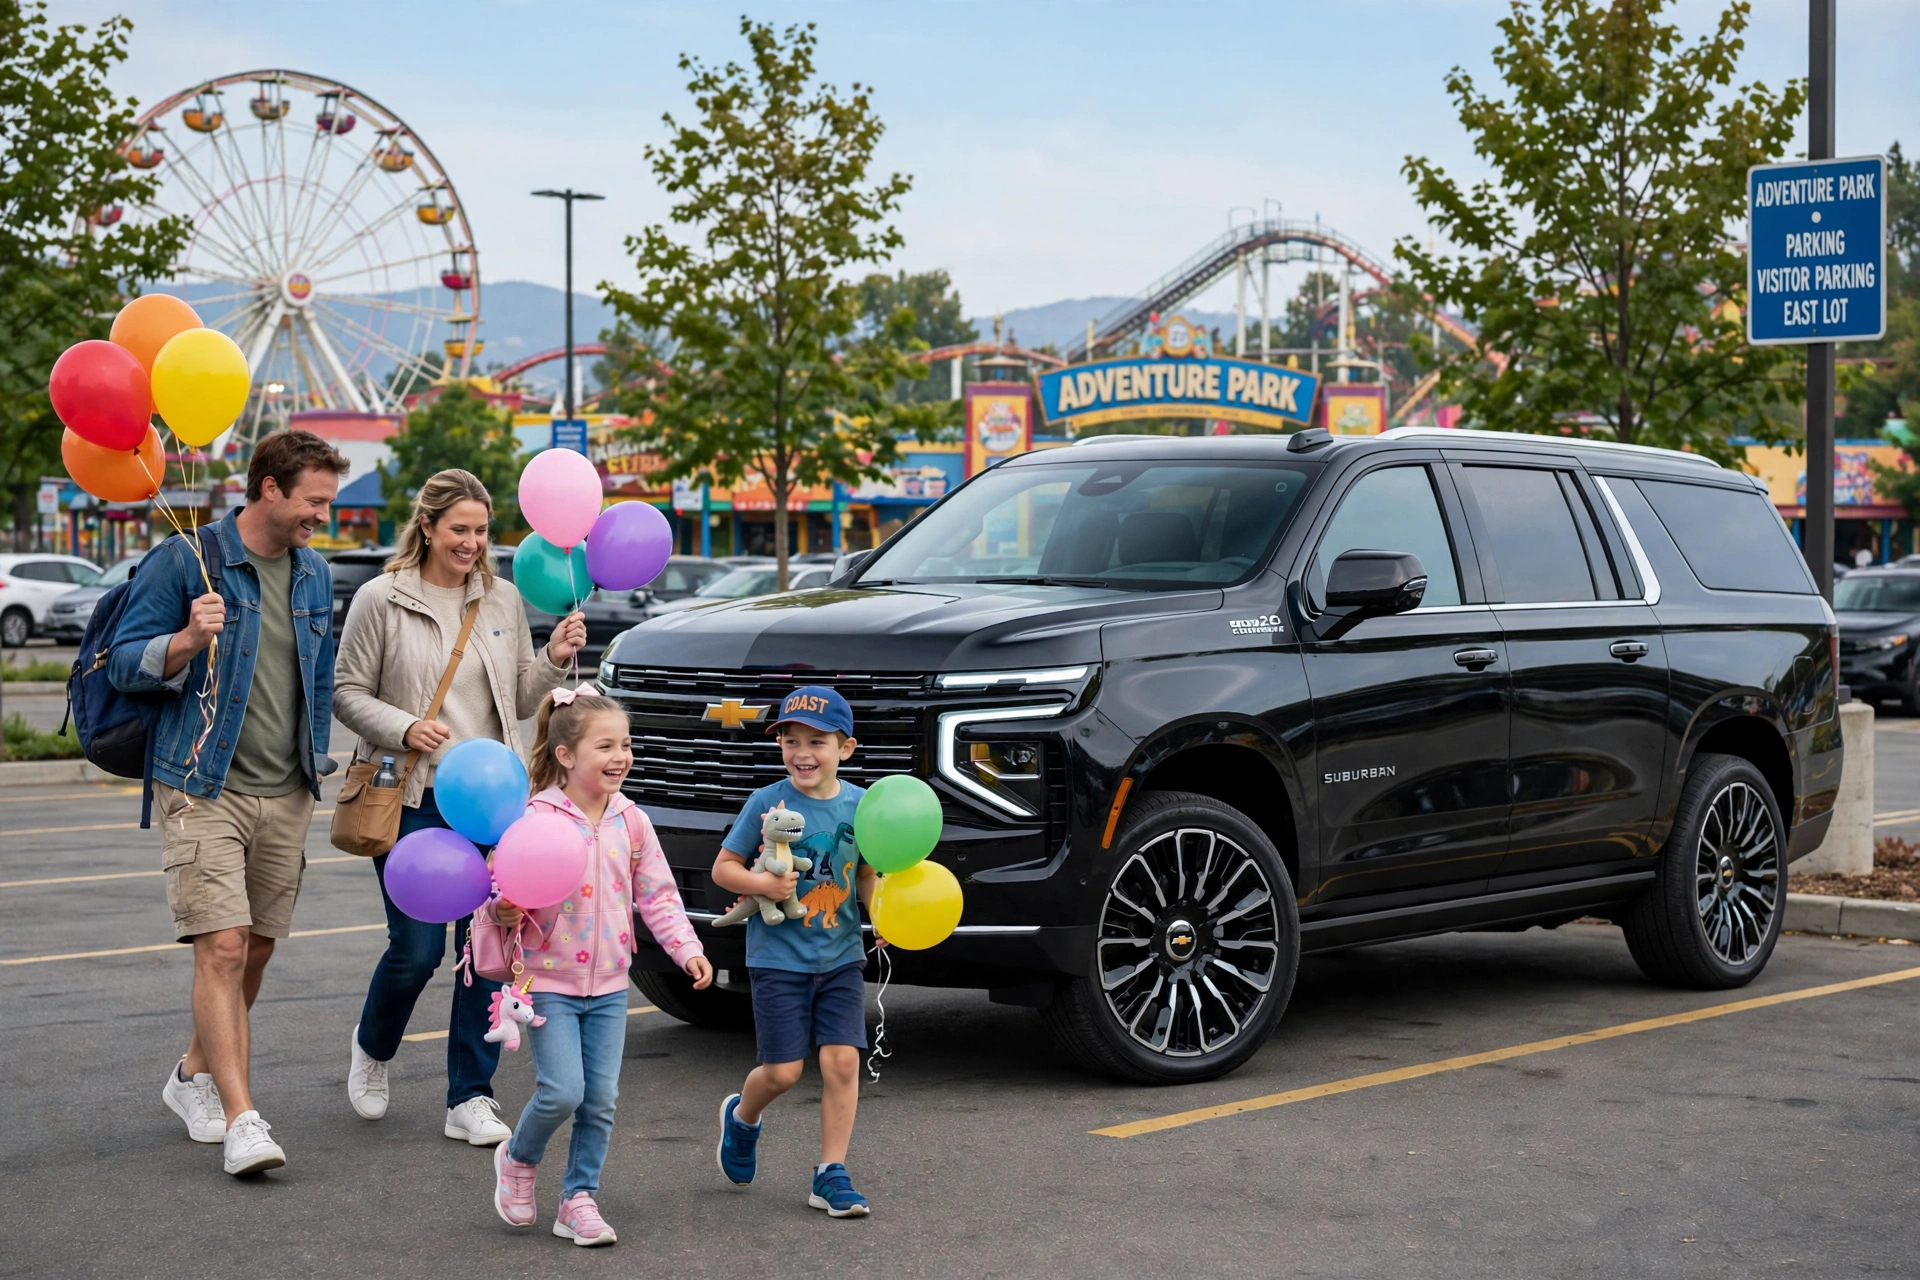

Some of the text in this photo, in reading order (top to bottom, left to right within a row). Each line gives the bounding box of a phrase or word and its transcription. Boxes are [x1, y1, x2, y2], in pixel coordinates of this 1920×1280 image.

[1755, 173, 1876, 207] ADVENTURE PARK
[1786, 229, 1845, 258] PARKING
[1757, 262, 1875, 294] VISITOR PARKING
[1783, 298, 1849, 326] EAST LOT
[1057, 363, 1302, 413] ADVENTURE PARK
[784, 694, 829, 714] COAST
[1324, 765, 1396, 784] SUBURBAN
